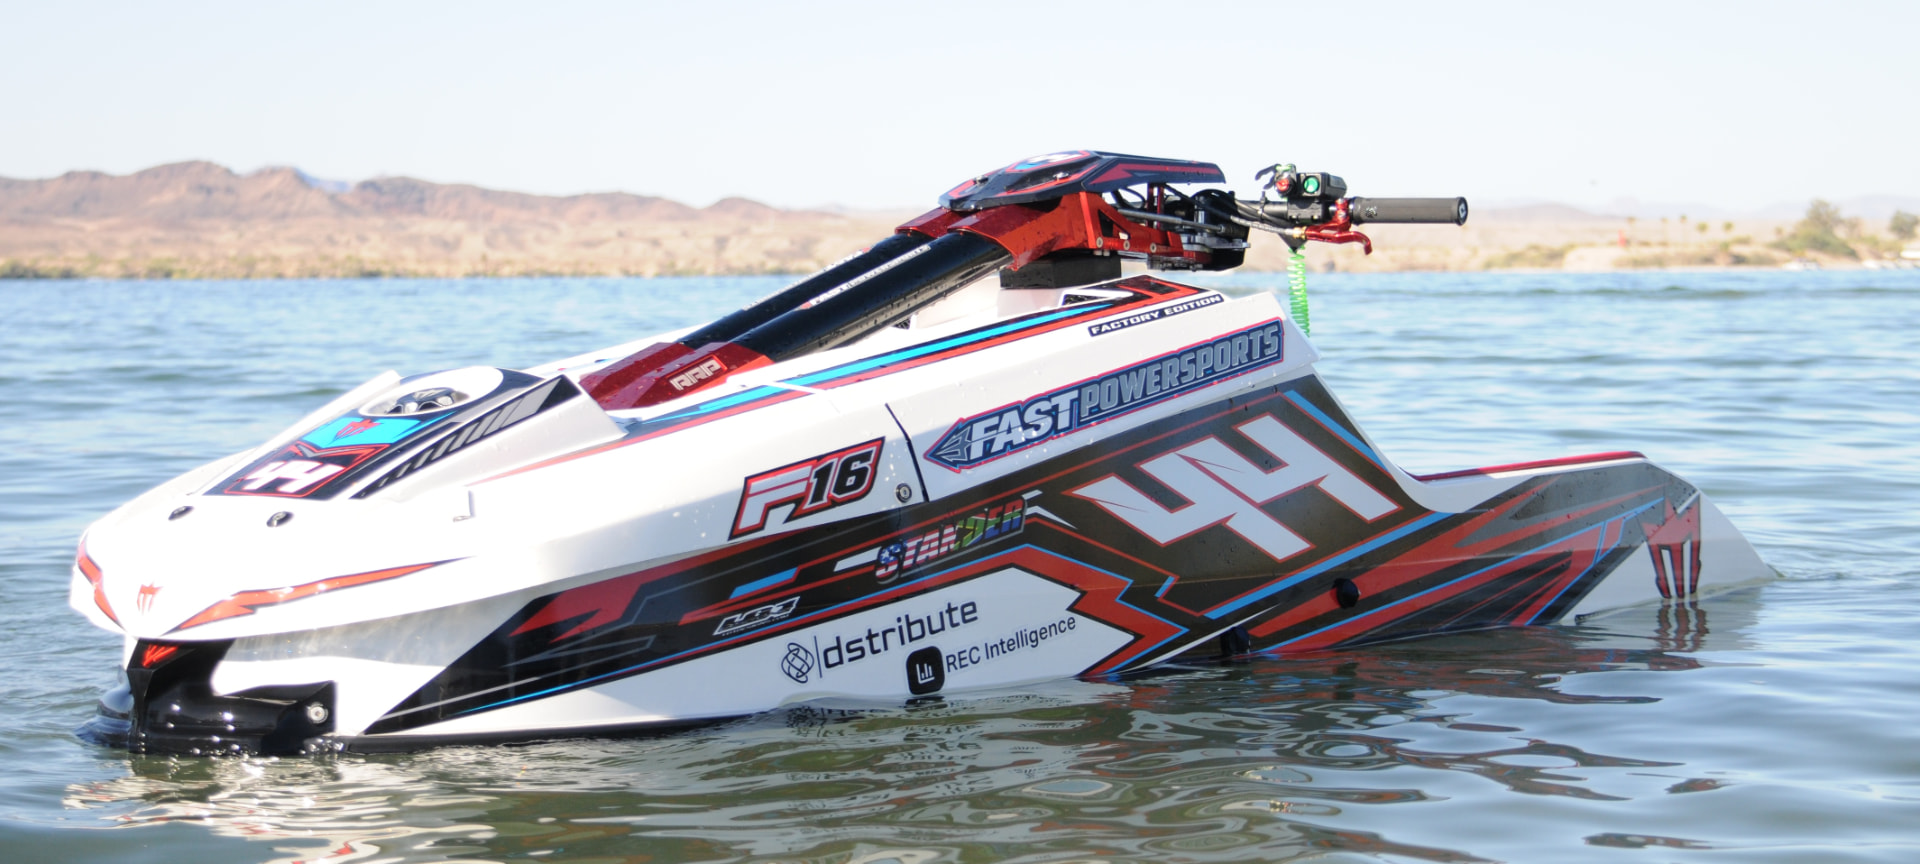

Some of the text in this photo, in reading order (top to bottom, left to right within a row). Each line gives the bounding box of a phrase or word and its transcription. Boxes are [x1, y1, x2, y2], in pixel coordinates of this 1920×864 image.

[1090, 295, 1221, 335] FACTORY EDITION
[969, 326, 1279, 460] FAST POWERSPORTS
[242, 459, 346, 494] 44
[733, 440, 881, 535] F16
[1064, 412, 1403, 563] 44
[875, 499, 1024, 579] STANDER
[822, 601, 979, 669] dstribute
[945, 616, 1076, 673] REC Intelligence
